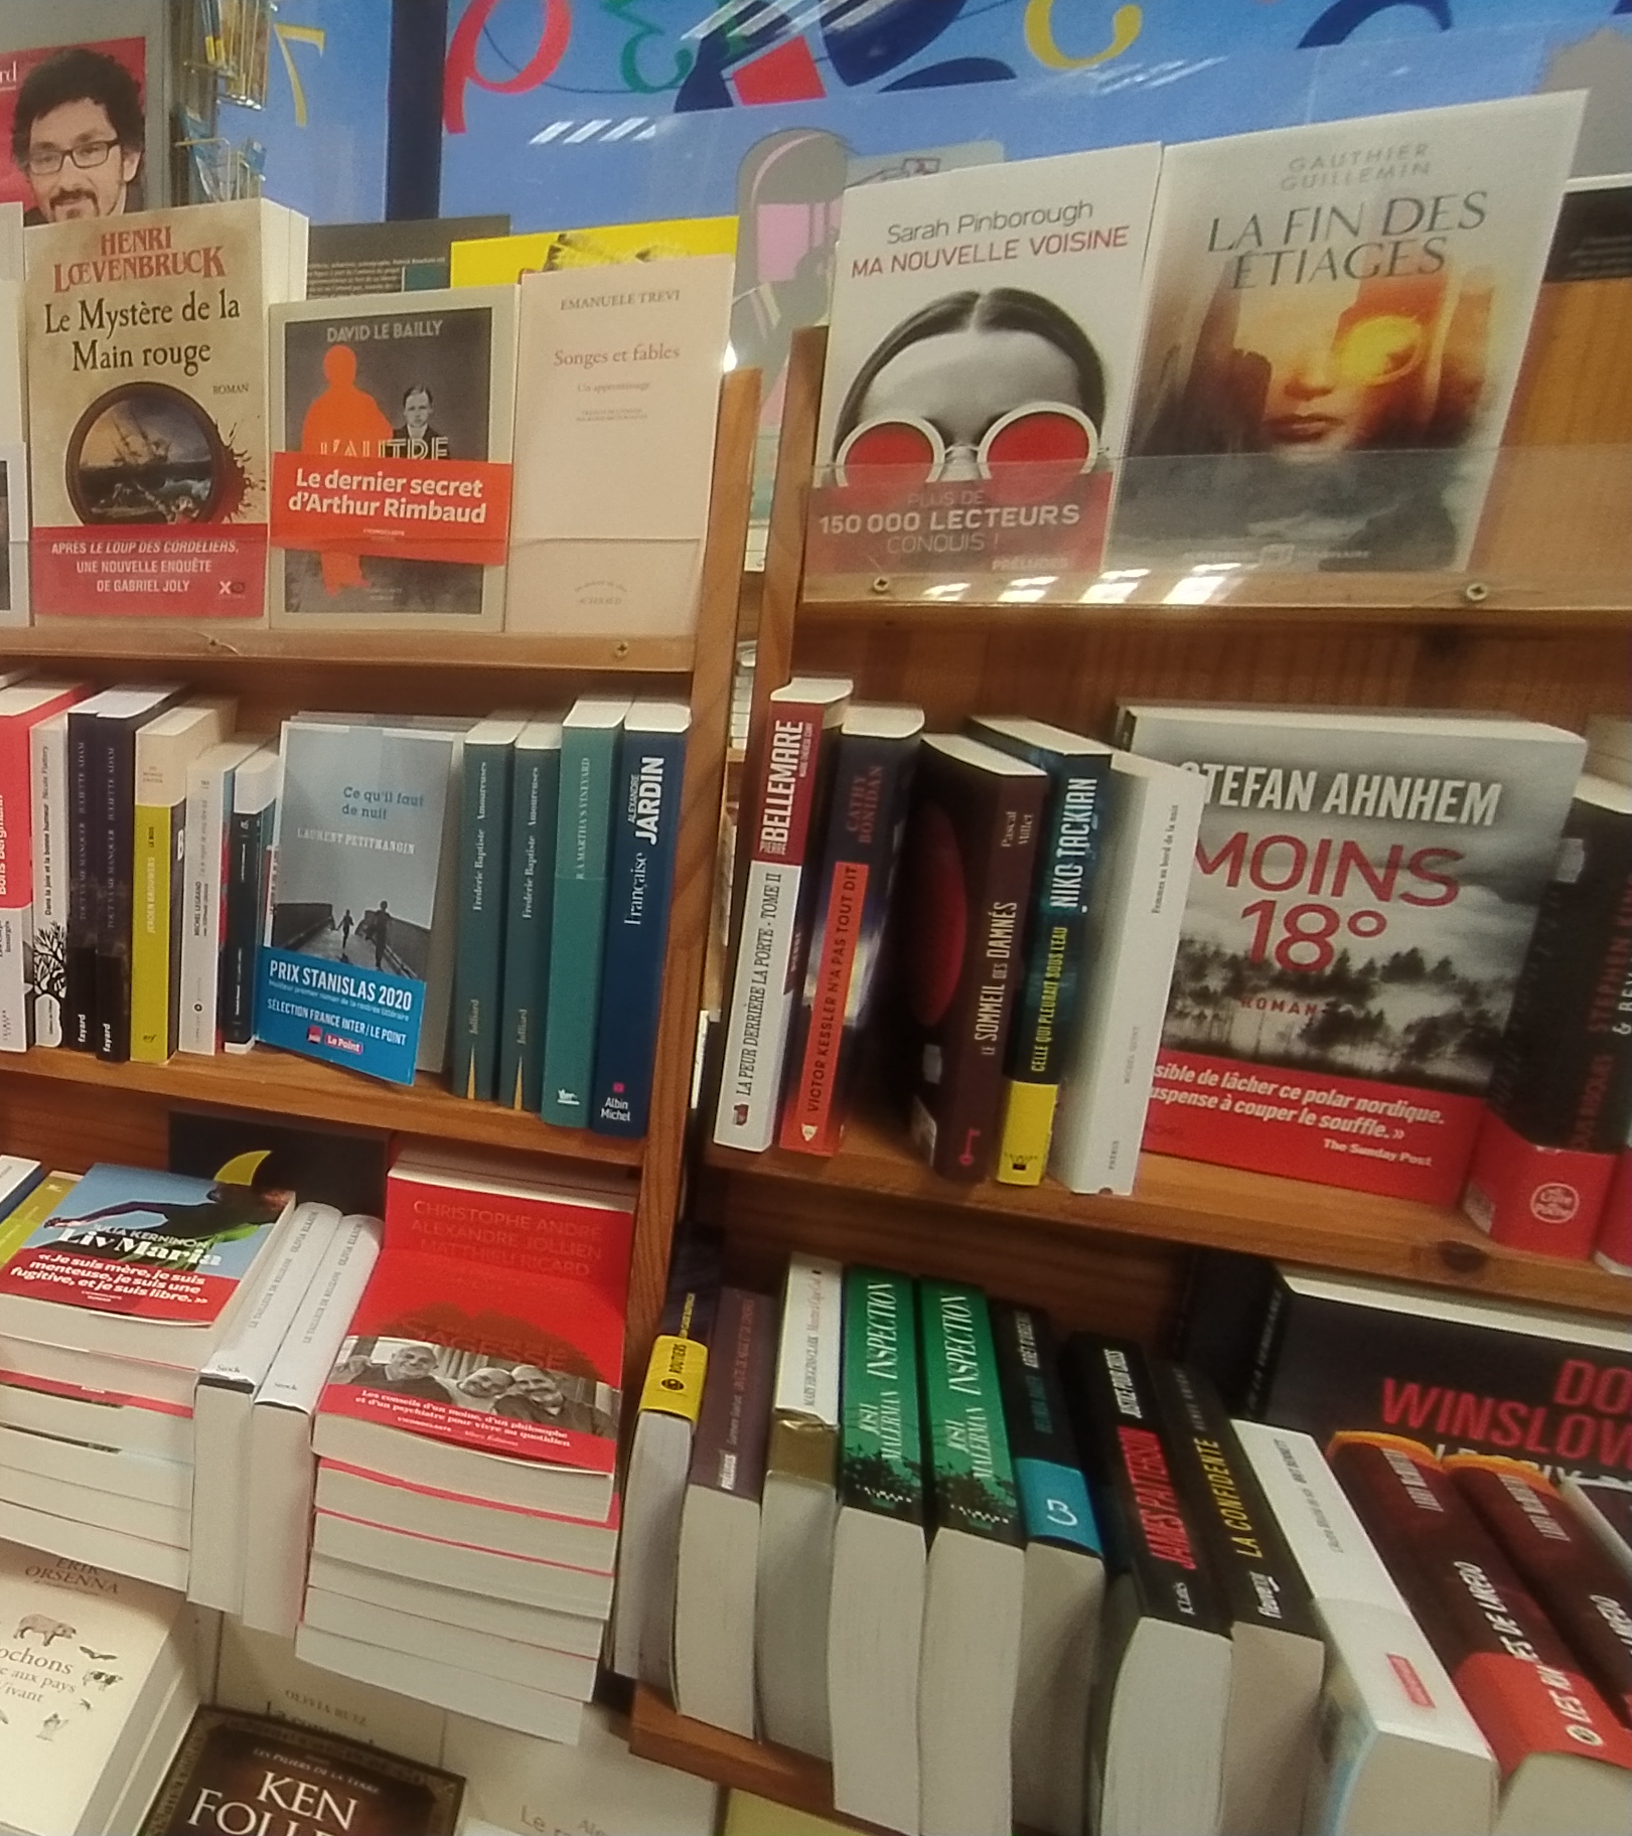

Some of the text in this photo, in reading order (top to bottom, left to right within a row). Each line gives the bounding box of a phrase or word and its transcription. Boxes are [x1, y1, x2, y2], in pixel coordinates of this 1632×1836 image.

[1280, 161, 1431, 191] GUILLEMIN
[1288, 143, 1430, 172] GAUTHIER
[887, 200, 1094, 245] Sarah Pinborough
[1208, 190, 1489, 252] LA FIN DES
[100, 226, 172, 256] HENRI
[851, 226, 1130, 279] MA NOUVELLE VOISINE
[53, 246, 226, 293] LŒVENBRUCK
[1232, 237, 1448, 289] ÉTIAGES
[44, 287, 240, 340] Le Mystère de la
[560, 289, 681, 311] EMANUELE TREVI
[327, 320, 444, 343] DAVID LE BAILLY
[72, 338, 212, 377] Main rouge
[554, 343, 681, 369] Songes et fables
[212, 383, 249, 396] ROMAN
[296, 467, 483, 498] Le dernier secret
[288, 491, 487, 524] d'Arthur Rimbaud
[819, 504, 1081, 534] 150 000 LECTEURS
[76, 557, 212, 574] UNE NOUVELLE ENQUÊTE
[96, 579, 190, 593] DE GABRIEL JOLY
[343, 786, 425, 808] Ce qu'il faut
[629, 773, 640, 824] ALEXANDRE
[761, 720, 804, 843] BELLEMARE
[1321, 772, 1503, 827] AHNHEM
[342, 804, 388, 820] de nuit
[635, 756, 666, 846] JARDIN
[847, 775, 867, 832] CATHY
[859, 766, 883, 843] BONIDAN
[296, 827, 416, 856] LAURENT PETITMANGIN
[1001, 811, 1017, 848] Pascal
[1049, 777, 1098, 909] NIKO TACKIAN
[1195, 831, 1465, 908] MOINS
[624, 852, 648, 926] Française
[1241, 898, 1388, 973] 18°
[269, 959, 412, 1011] PRIX STANISLAS 2020
[1241, 997, 1319, 1019] ROMAN
[77, 1013, 87, 1044] fayard
[103, 1022, 112, 1053] fayard
[600, 1107, 631, 1122] Michel
[604, 1097, 629, 1111] Albin
[1323, 1137, 1433, 1167] The Sunday Post
[58, 1228, 223, 1266] Liv Maria
[29, 1261, 202, 1294] menteuse, je suis une
[865, 1281, 899, 1381] INSPECTION
[948, 1293, 982, 1397] INSPECTION
[872, 1389, 903, 1462] MALERMAN
[967, 1406, 996, 1481] MALERMAN
[1194, 1437, 1264, 1559] LA CONFIDENTE
[24, 1563, 120, 1596] ORSENNA
[11, 1665, 38, 1681] aux
[39, 1673, 78, 1695] pays
[256, 1770, 359, 1832] KEN
